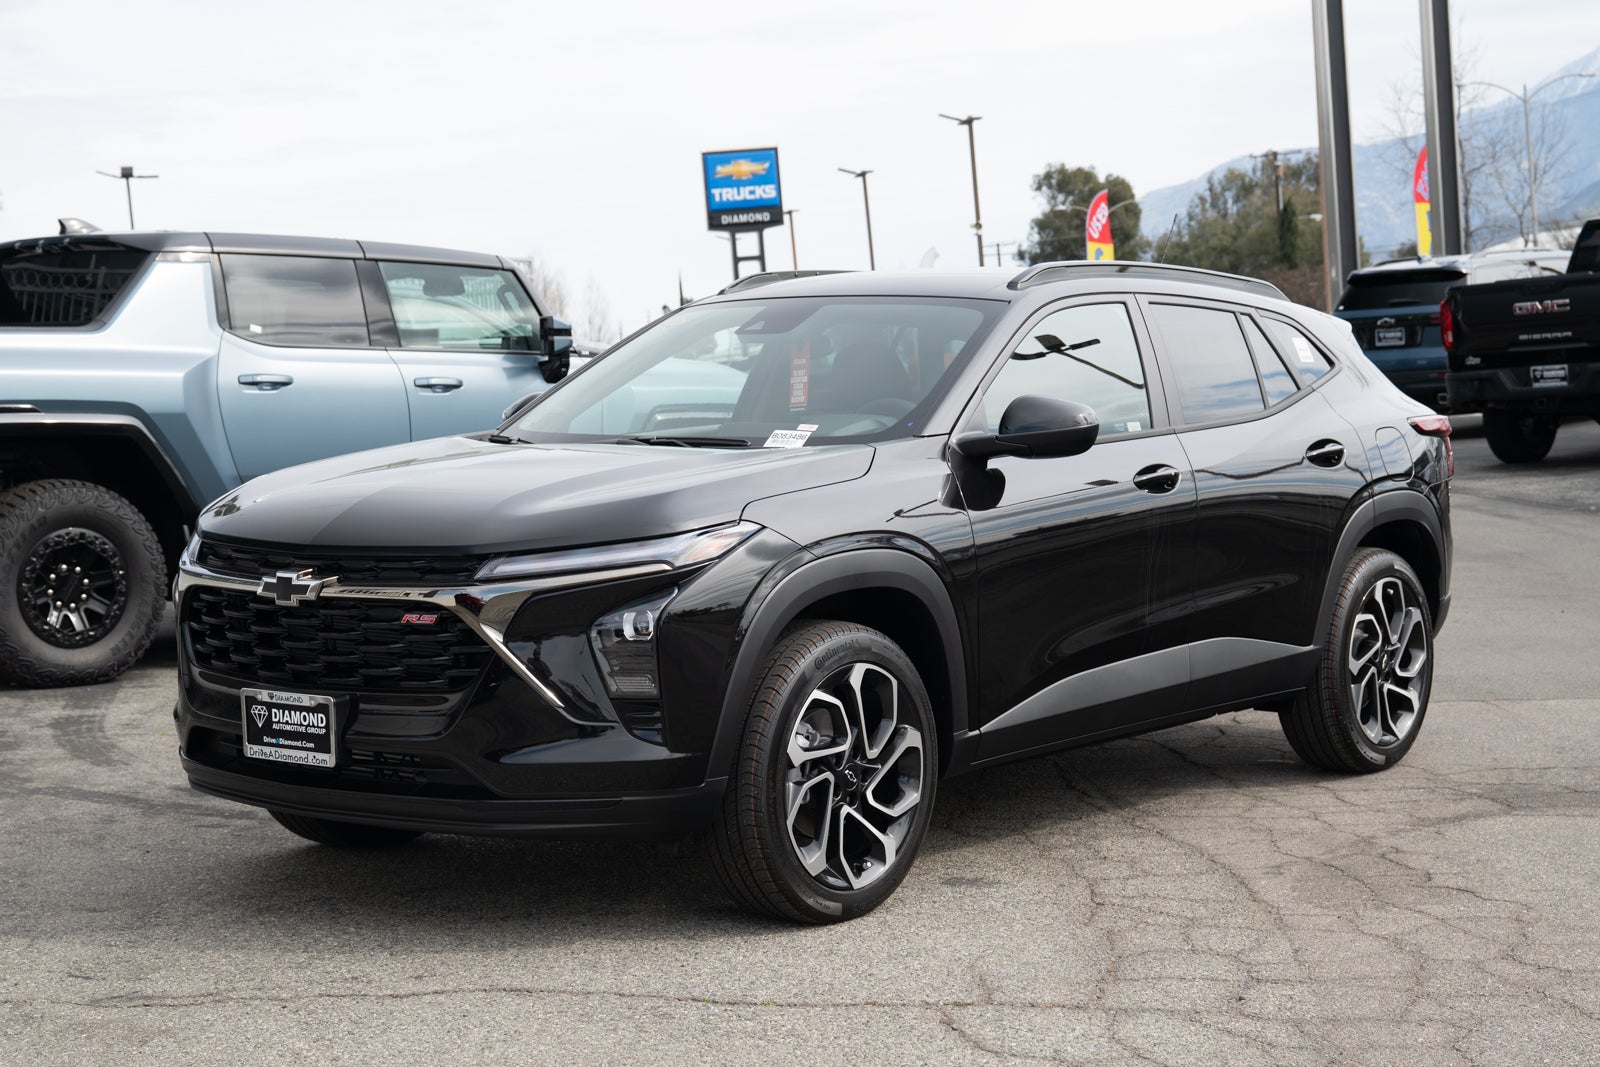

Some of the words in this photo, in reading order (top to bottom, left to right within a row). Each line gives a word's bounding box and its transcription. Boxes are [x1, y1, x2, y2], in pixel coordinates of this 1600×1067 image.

[711, 184, 777, 202] TRUCKS
[721, 212, 771, 225] DIAMOND
[1089, 202, 1109, 239] USED
[1513, 298, 1570, 316] GMC
[1518, 331, 1572, 340] SIERRA
[401, 614, 438, 624] RS
[815, 640, 855, 669] Continental
[274, 694, 303, 704] DIAMOND
[271, 708, 326, 727] DIAMOND
[272, 723, 306, 733] AUTOMOTIVE
[307, 727, 326, 735] GROUP
[249, 747, 328, 766] DriveADiamond.com
